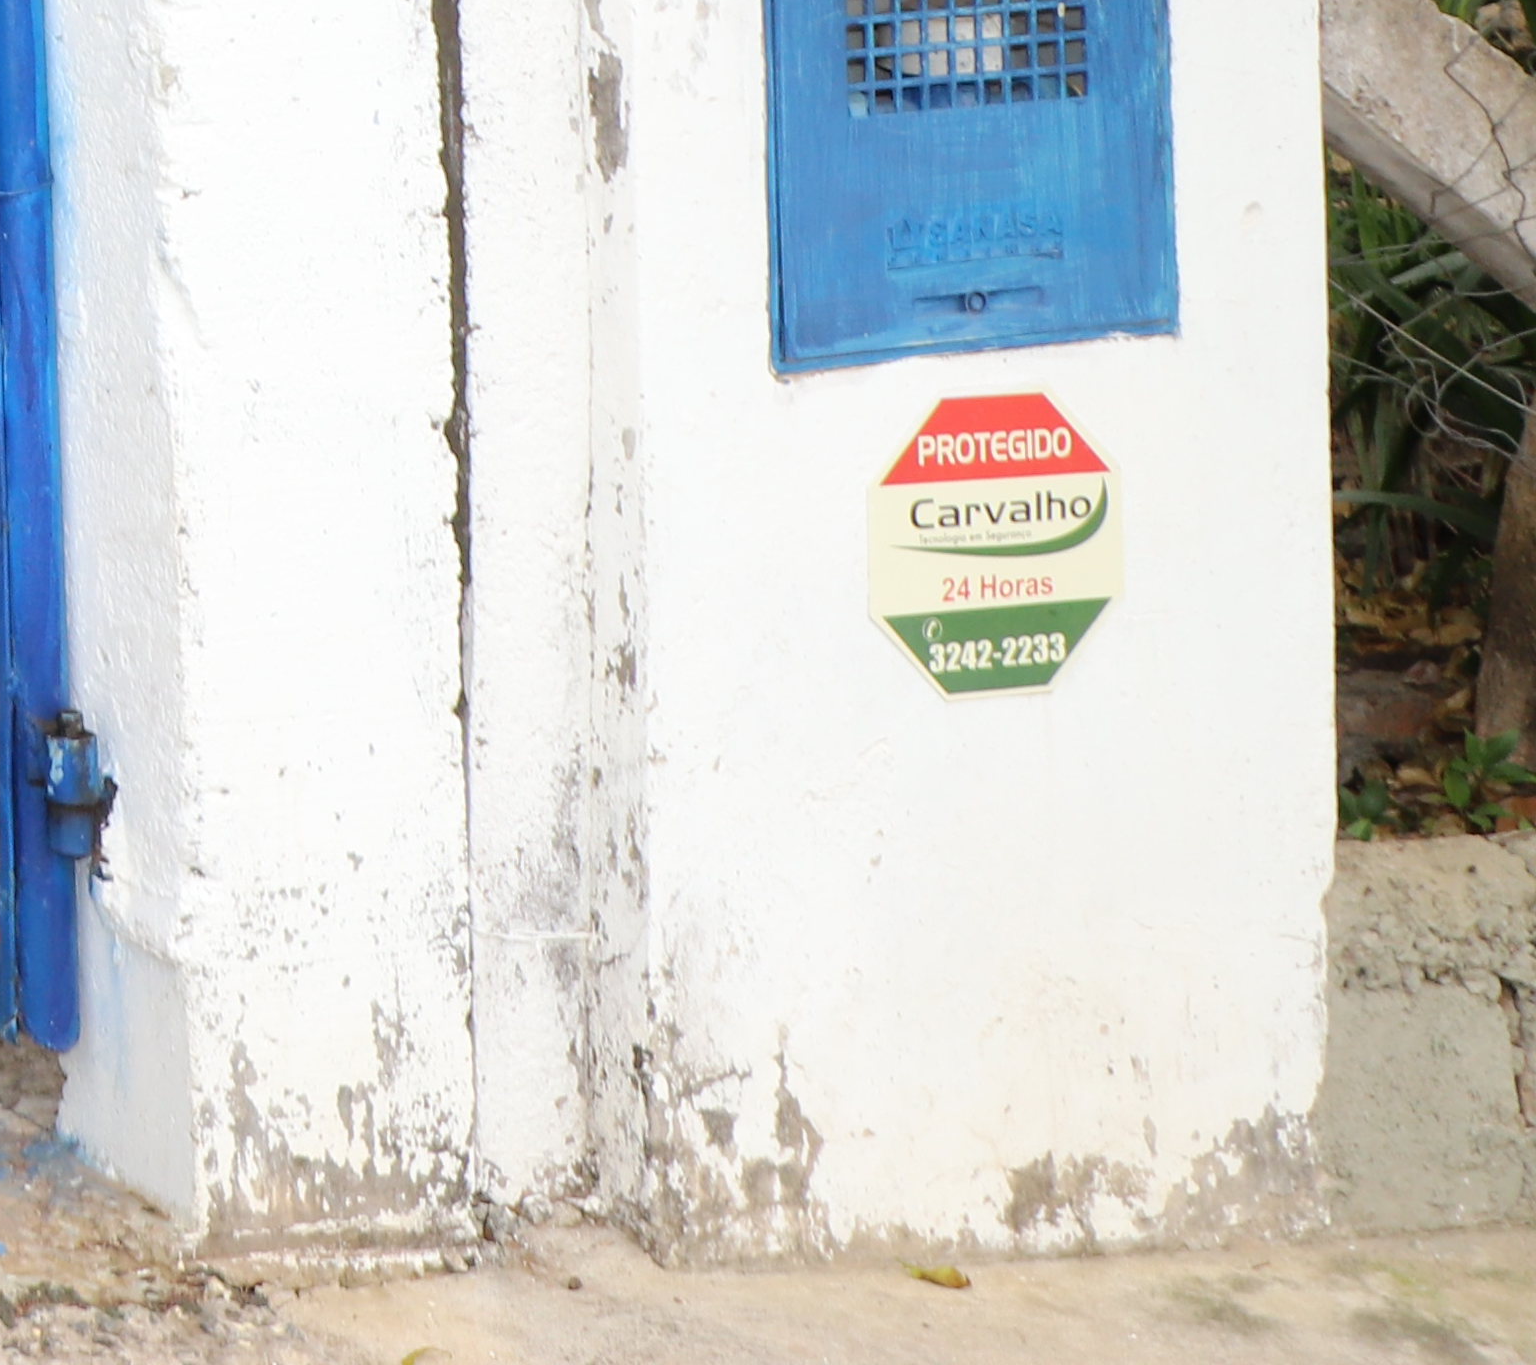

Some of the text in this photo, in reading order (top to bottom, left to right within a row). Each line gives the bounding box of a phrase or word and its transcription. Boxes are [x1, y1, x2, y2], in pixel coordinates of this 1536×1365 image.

[917, 426, 1073, 468] PROTEGIDO
[909, 490, 1092, 530] Carvalho
[917, 533, 967, 546] Tecnologia
[969, 534, 983, 542] em
[942, 574, 1054, 603] 24 Horas
[928, 632, 1068, 674] 3242-2233
